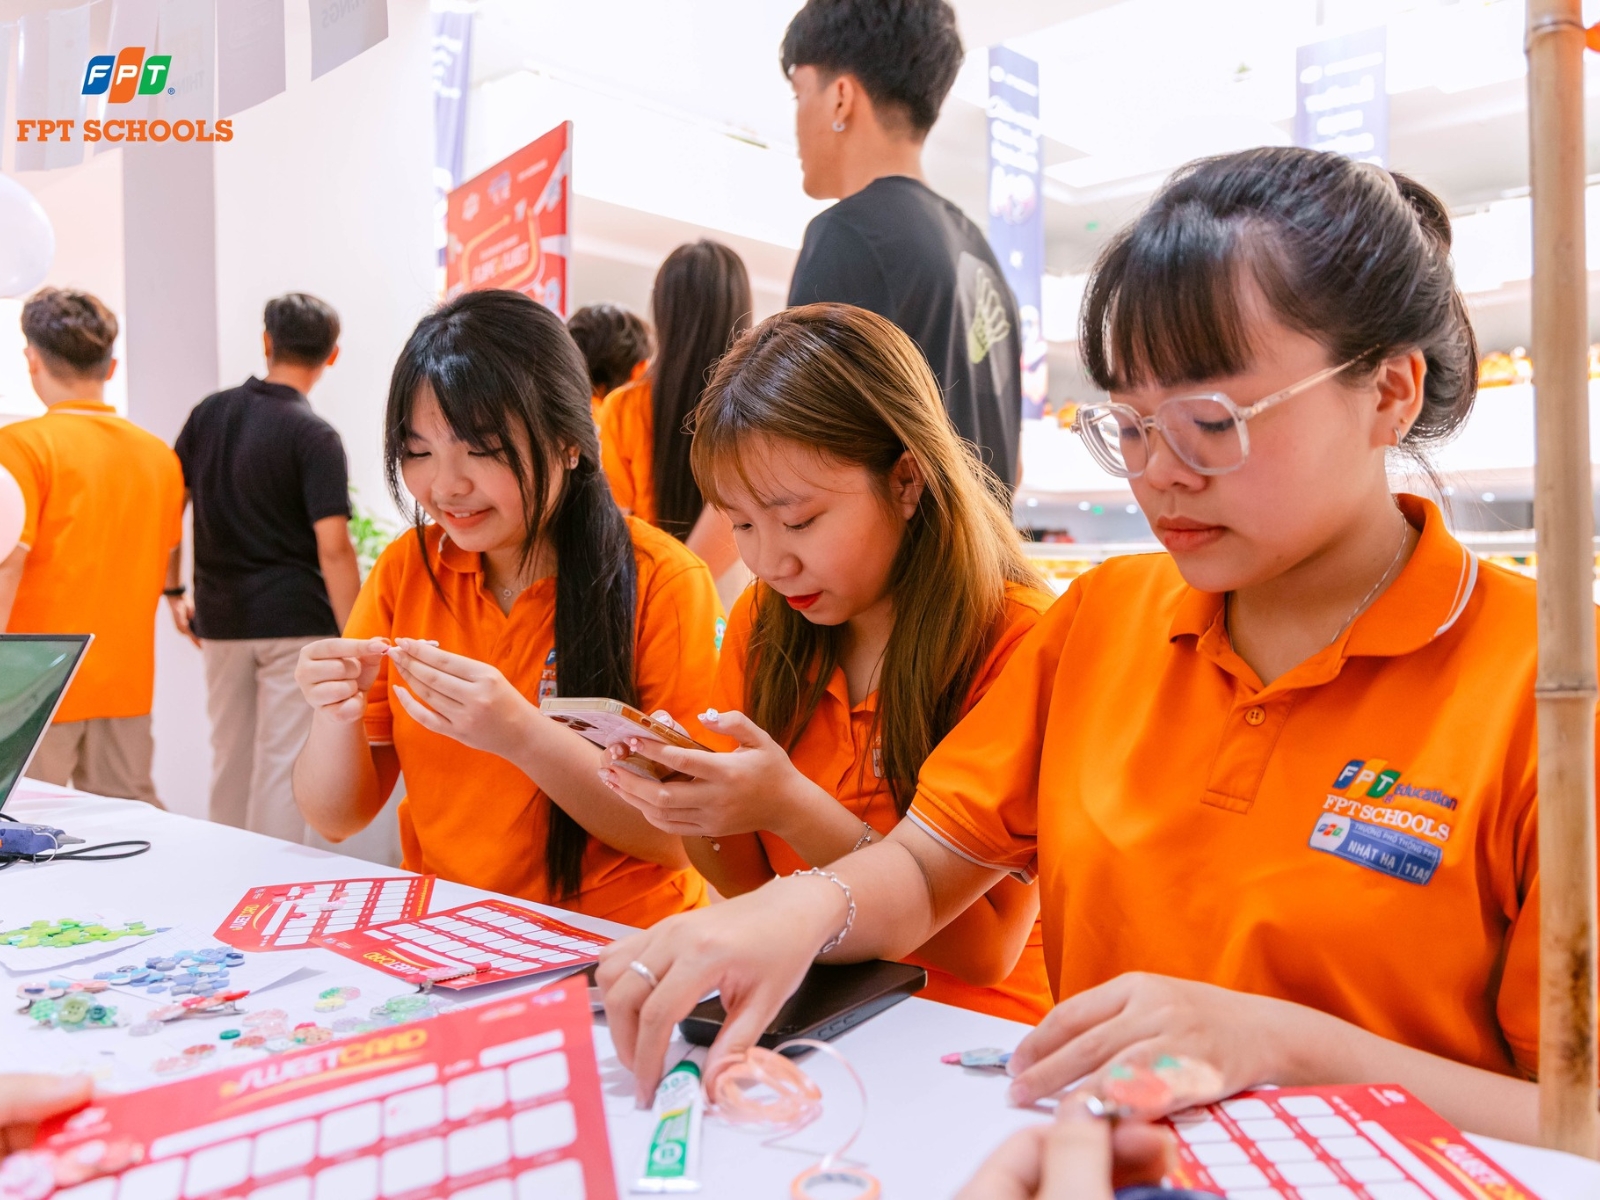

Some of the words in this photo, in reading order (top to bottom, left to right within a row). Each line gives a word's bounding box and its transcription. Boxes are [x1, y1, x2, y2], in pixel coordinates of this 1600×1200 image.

[1337, 765, 1395, 793] FPT
[1322, 794, 1362, 817] FPT
[1358, 805, 1451, 842] SCHOOLS
